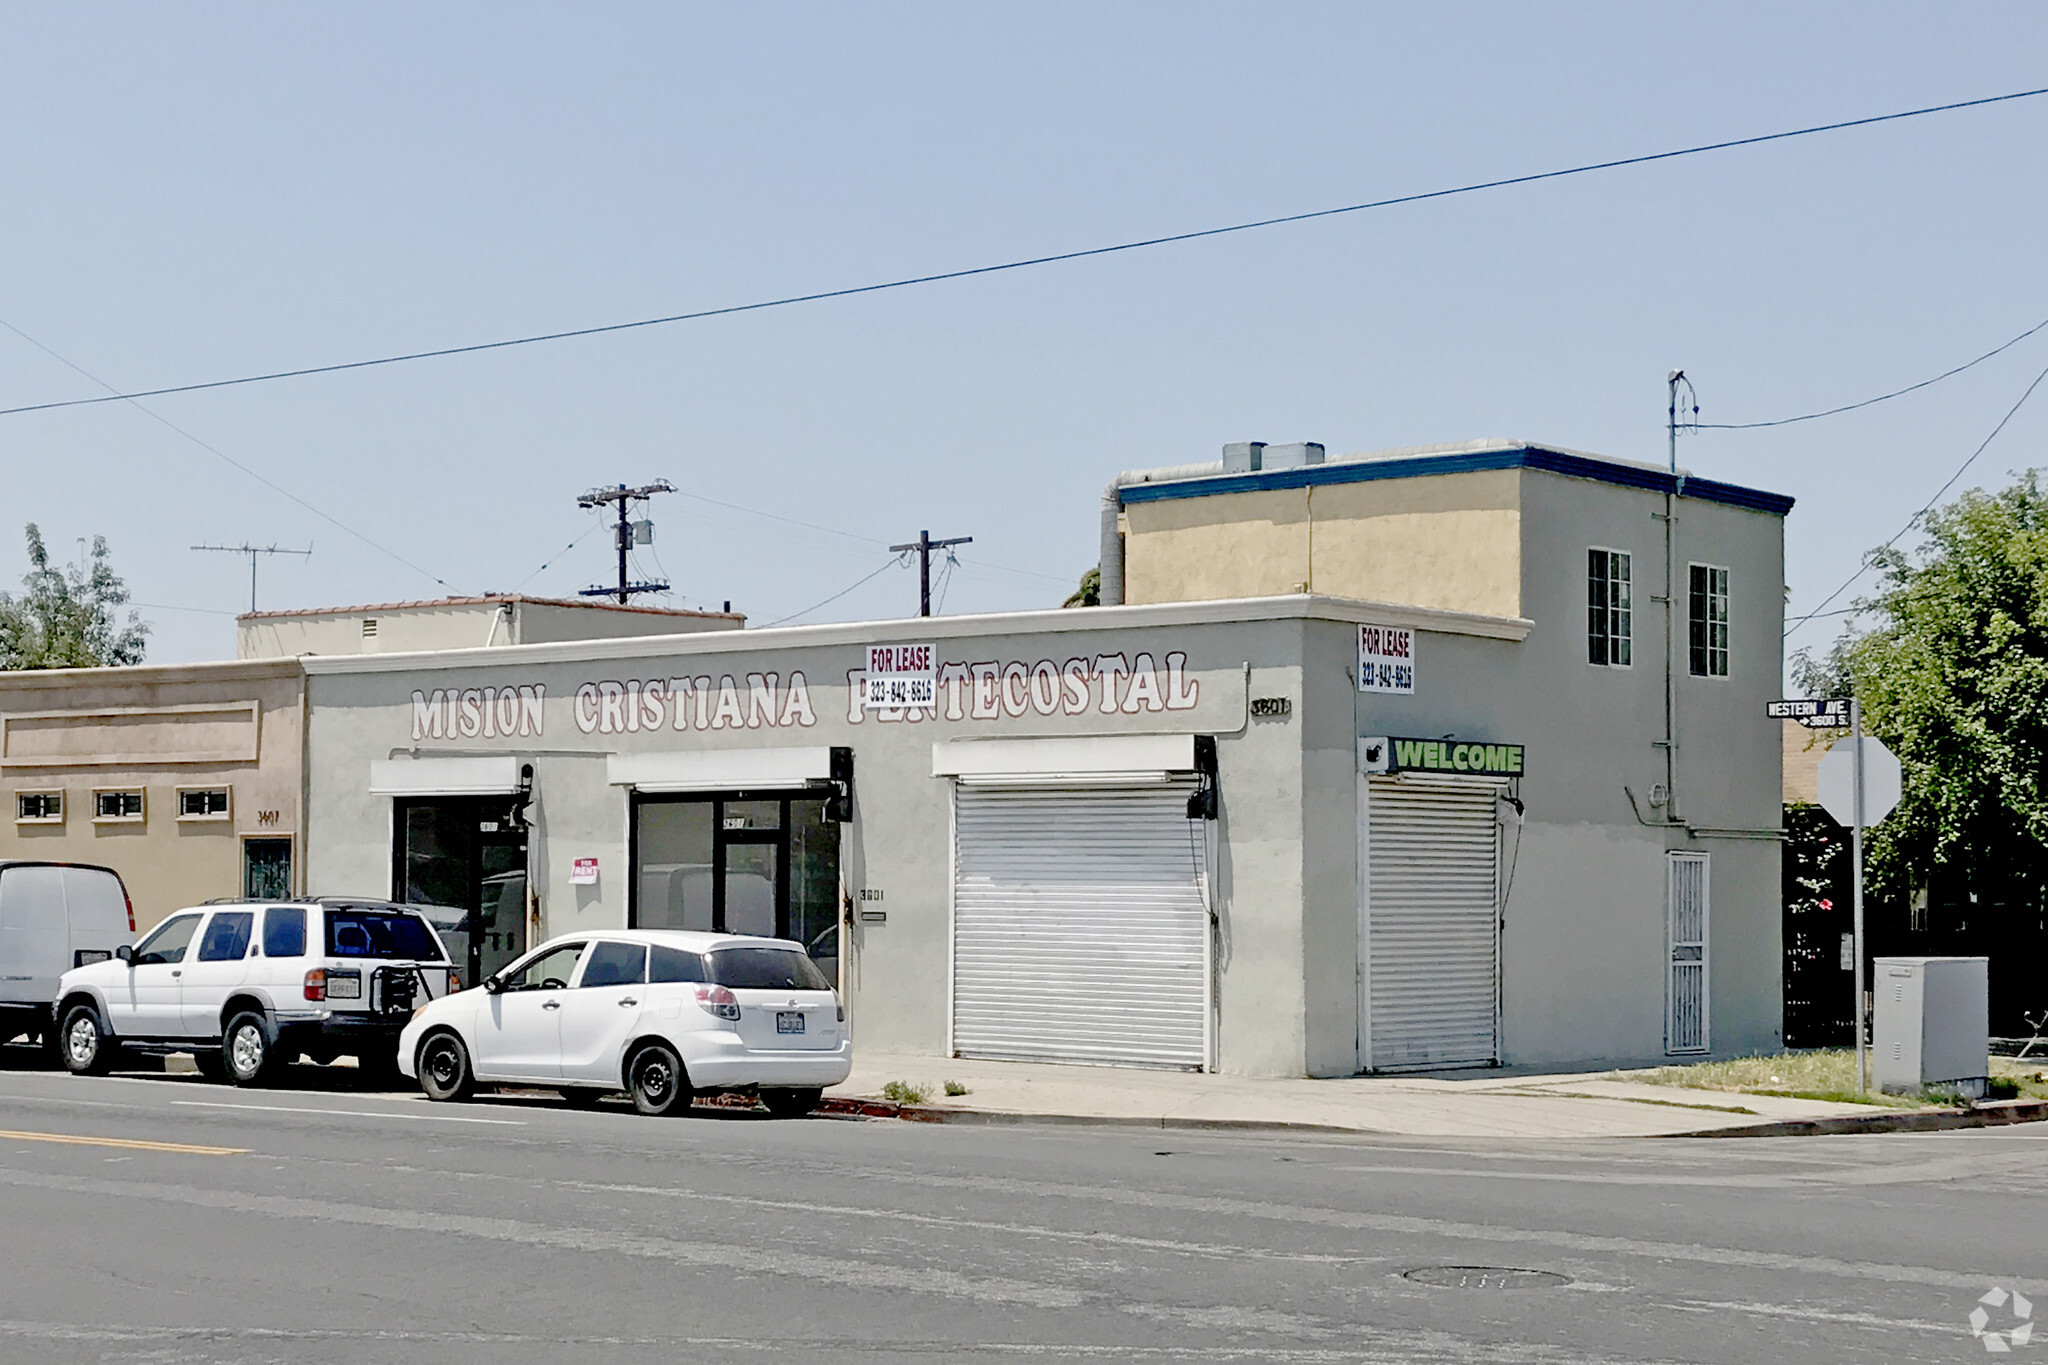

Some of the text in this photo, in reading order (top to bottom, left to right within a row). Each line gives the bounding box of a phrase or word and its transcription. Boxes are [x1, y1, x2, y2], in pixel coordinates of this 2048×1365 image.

[1362, 627, 1409, 658] FOR LEASE
[871, 646, 930, 673] FOR LEASE
[411, 651, 1199, 741] MISION CRISTIANA PTECOSTAL
[870, 679, 932, 703] 323-842-8616
[1768, 702, 1817, 716] WESTERN
[1809, 715, 1836, 726] 3600
[1395, 741, 1523, 772] WELCOME
[574, 866, 598, 876] RENT
[860, 889, 884, 901] 3601
